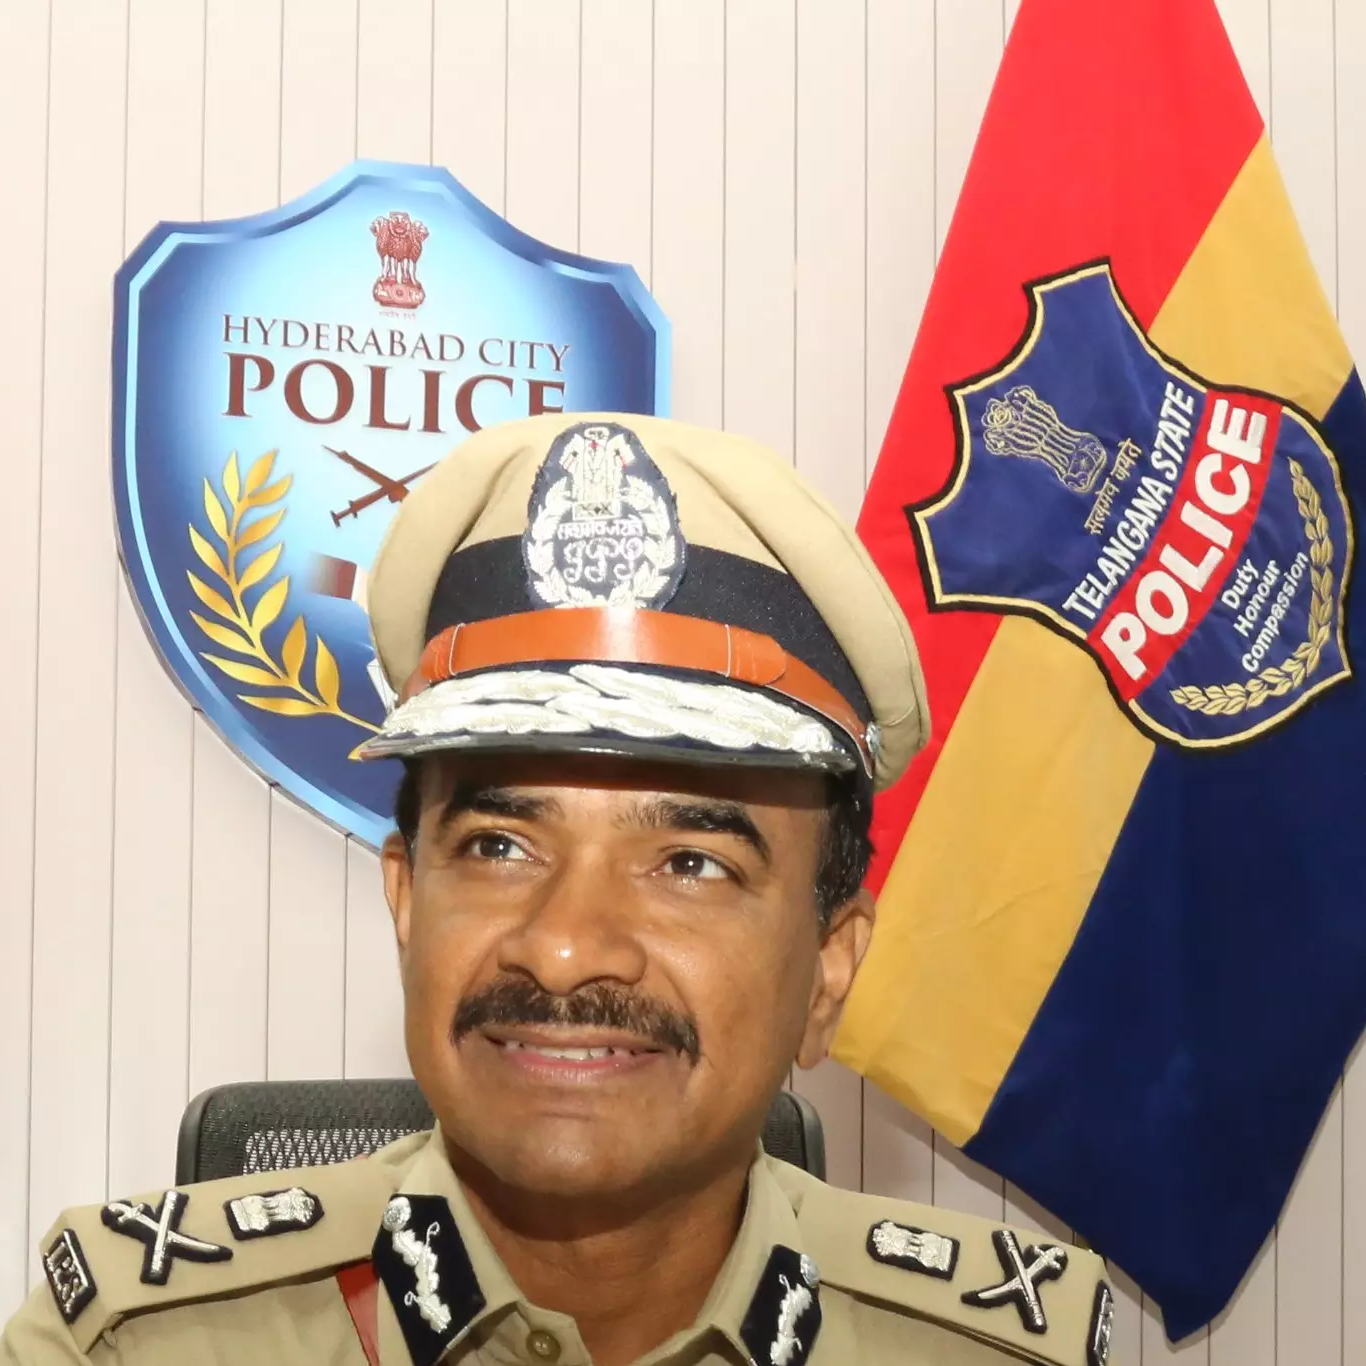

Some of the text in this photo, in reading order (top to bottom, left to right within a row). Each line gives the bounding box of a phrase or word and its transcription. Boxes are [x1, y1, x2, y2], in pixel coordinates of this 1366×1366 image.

[223, 314, 571, 372] HYDERABAD CITY
[221, 352, 566, 434] POLICE
[1110, 438, 1143, 481] जयते
[1062, 381, 1195, 622] TELANGANA STATE
[1101, 399, 1268, 681] POLICE
[1221, 558, 1259, 611] Duty
[1233, 559, 1280, 637] Honour
[1242, 551, 1310, 673] Compassion
